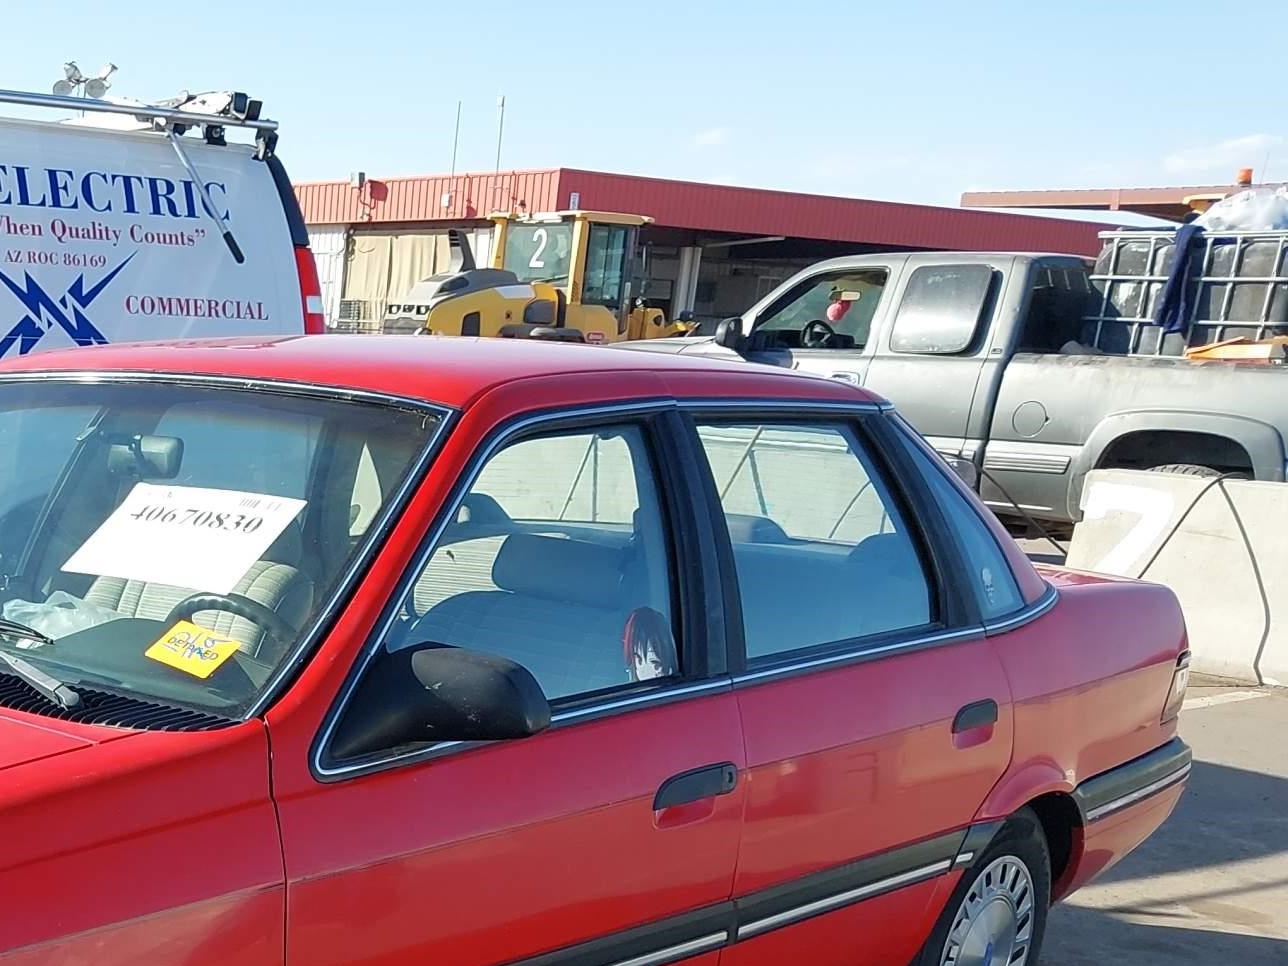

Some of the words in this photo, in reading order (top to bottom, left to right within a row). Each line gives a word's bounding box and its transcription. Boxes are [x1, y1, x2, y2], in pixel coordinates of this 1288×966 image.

[50, 218, 123, 247] Quality
[5, 249, 23, 264] AZ
[27, 250, 59, 265] ROC
[63, 252, 107, 268] 86169
[528, 228, 548, 268] 2
[125, 295, 269, 321] COMMERCIAL
[130, 504, 264, 534] 40670830
